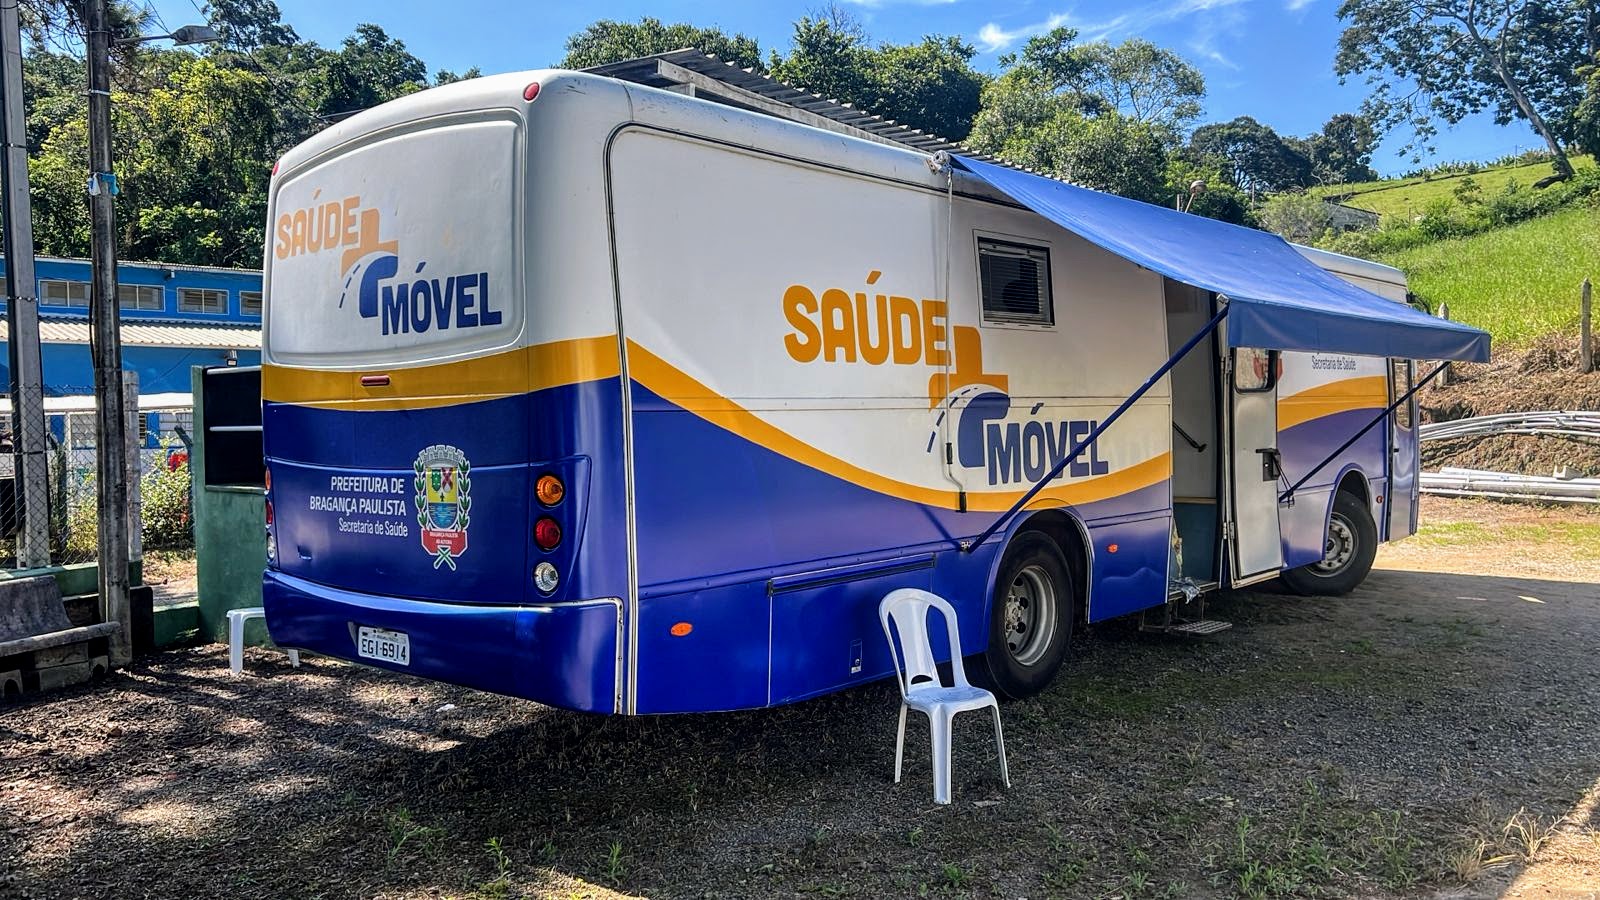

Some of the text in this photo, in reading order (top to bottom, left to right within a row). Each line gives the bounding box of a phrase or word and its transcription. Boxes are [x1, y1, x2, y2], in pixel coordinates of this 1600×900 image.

[276, 188, 361, 260] SAÚDE
[382, 261, 502, 336] MÓVEL
[783, 270, 952, 366] SAÚDE
[987, 402, 1109, 486] MÓVEL
[310, 495, 407, 516] BRAGANÇA PAULISTA
[330, 476, 405, 494] PREFEITURA DE
[338, 517, 408, 537] Secretaria de Saúde
[362, 638, 406, 660] EGI-6914
